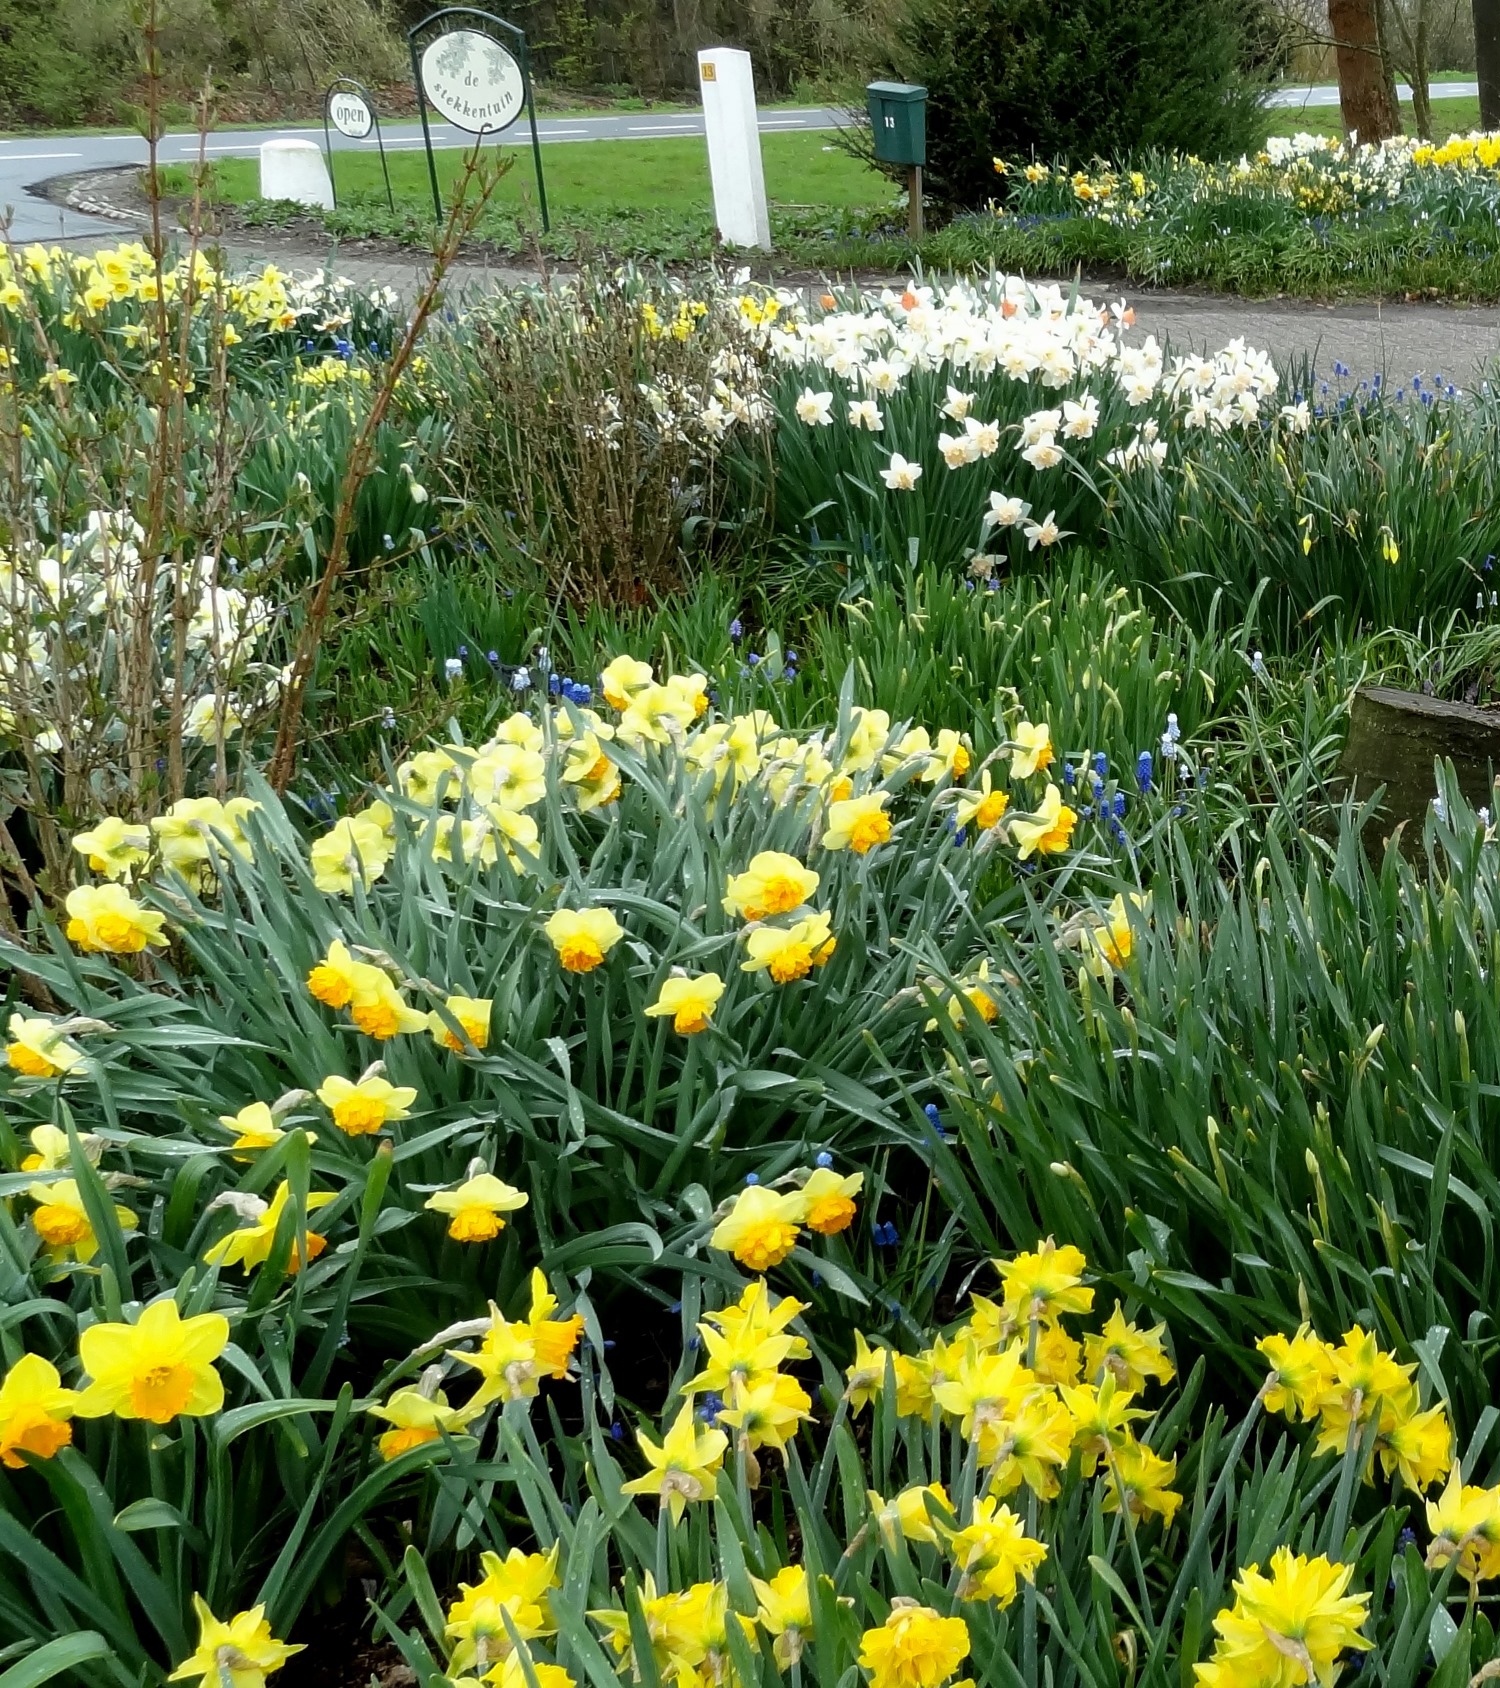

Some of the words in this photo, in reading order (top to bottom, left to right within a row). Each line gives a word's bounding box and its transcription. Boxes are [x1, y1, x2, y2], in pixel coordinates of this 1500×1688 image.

[464, 71, 479, 88] de
[703, 65, 714, 79] 13
[433, 83, 513, 118] stekkentuin
[336, 107, 364, 125] open
[884, 116, 895, 129] 13
